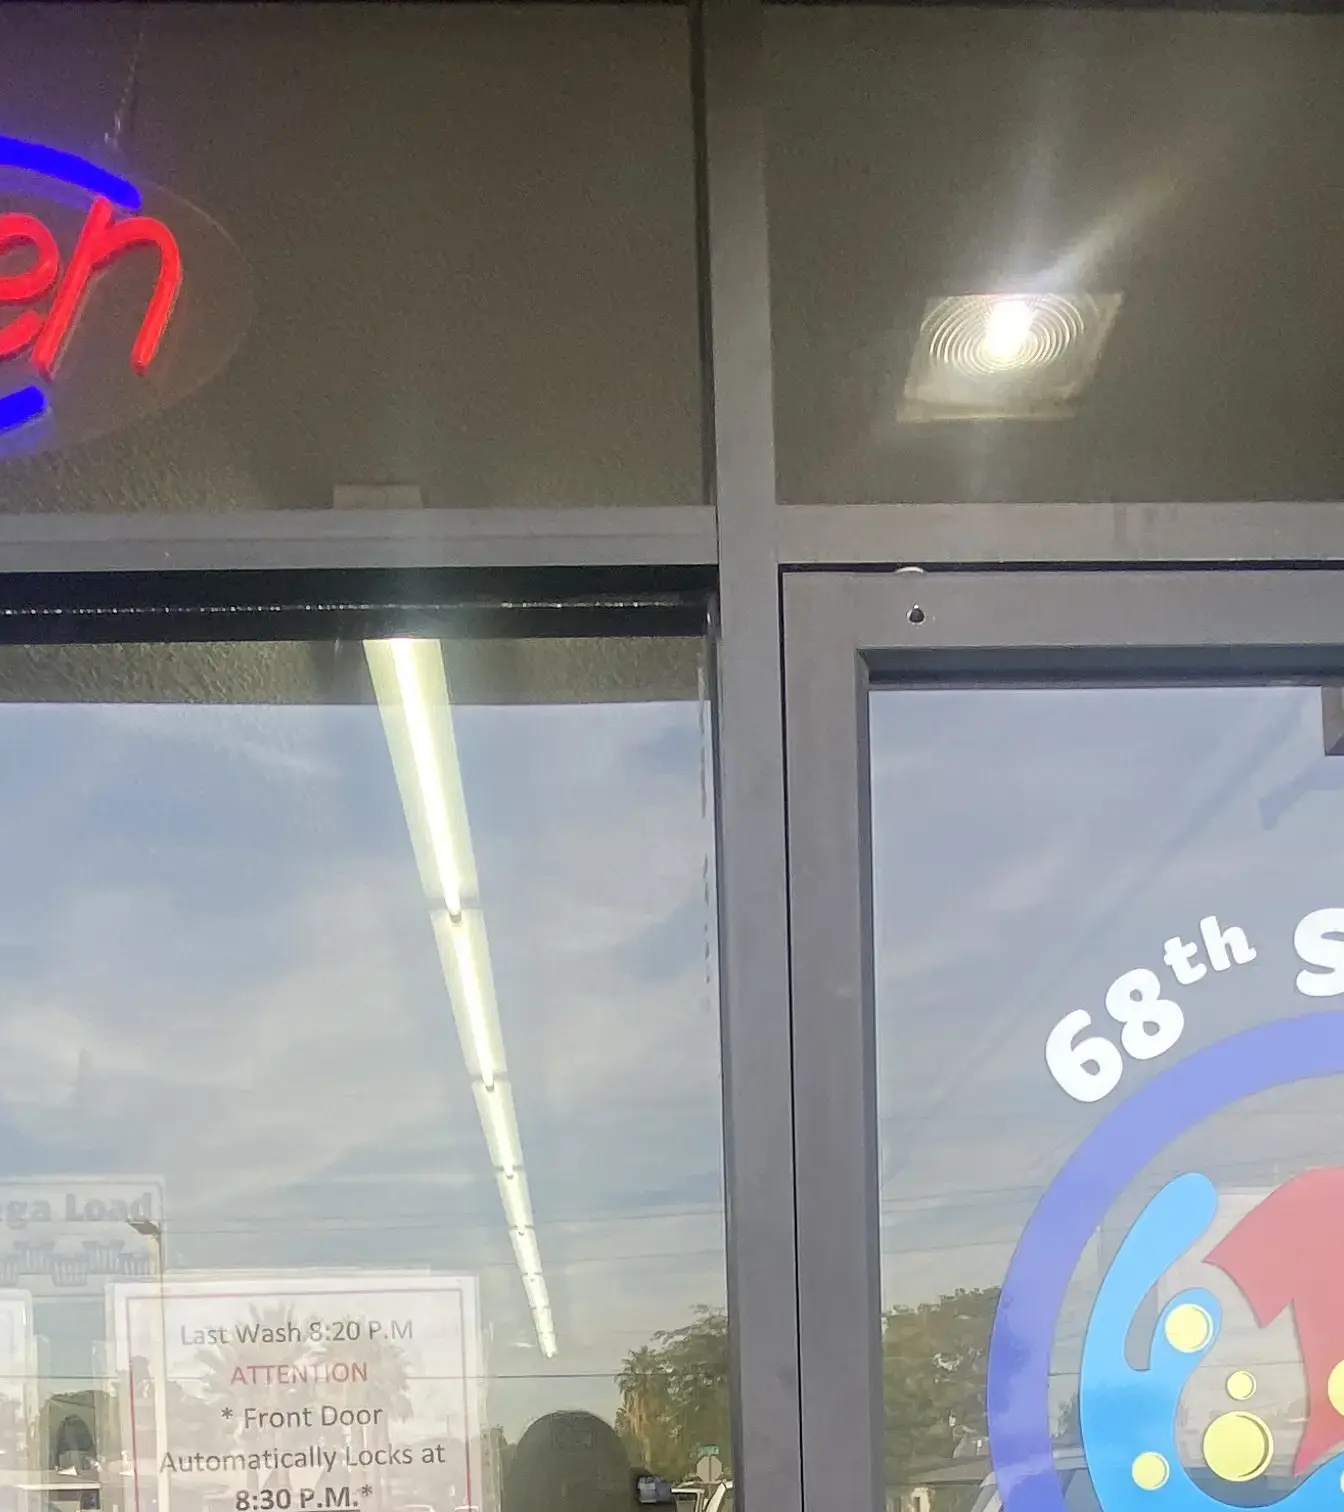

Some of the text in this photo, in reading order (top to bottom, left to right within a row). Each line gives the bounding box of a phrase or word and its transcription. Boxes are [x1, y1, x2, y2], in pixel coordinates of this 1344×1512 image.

[1044, 915, 1258, 1104] 68th
[65, 1192, 152, 1222] Load
[181, 1319, 414, 1346] Last Wash 8:20 P.M
[230, 1361, 369, 1387] ATTENTION
[244, 1407, 313, 1429] Front
[321, 1405, 385, 1427] Door
[159, 1444, 447, 1473] Automatically Locks at
[235, 1488, 293, 1512] 8:30
